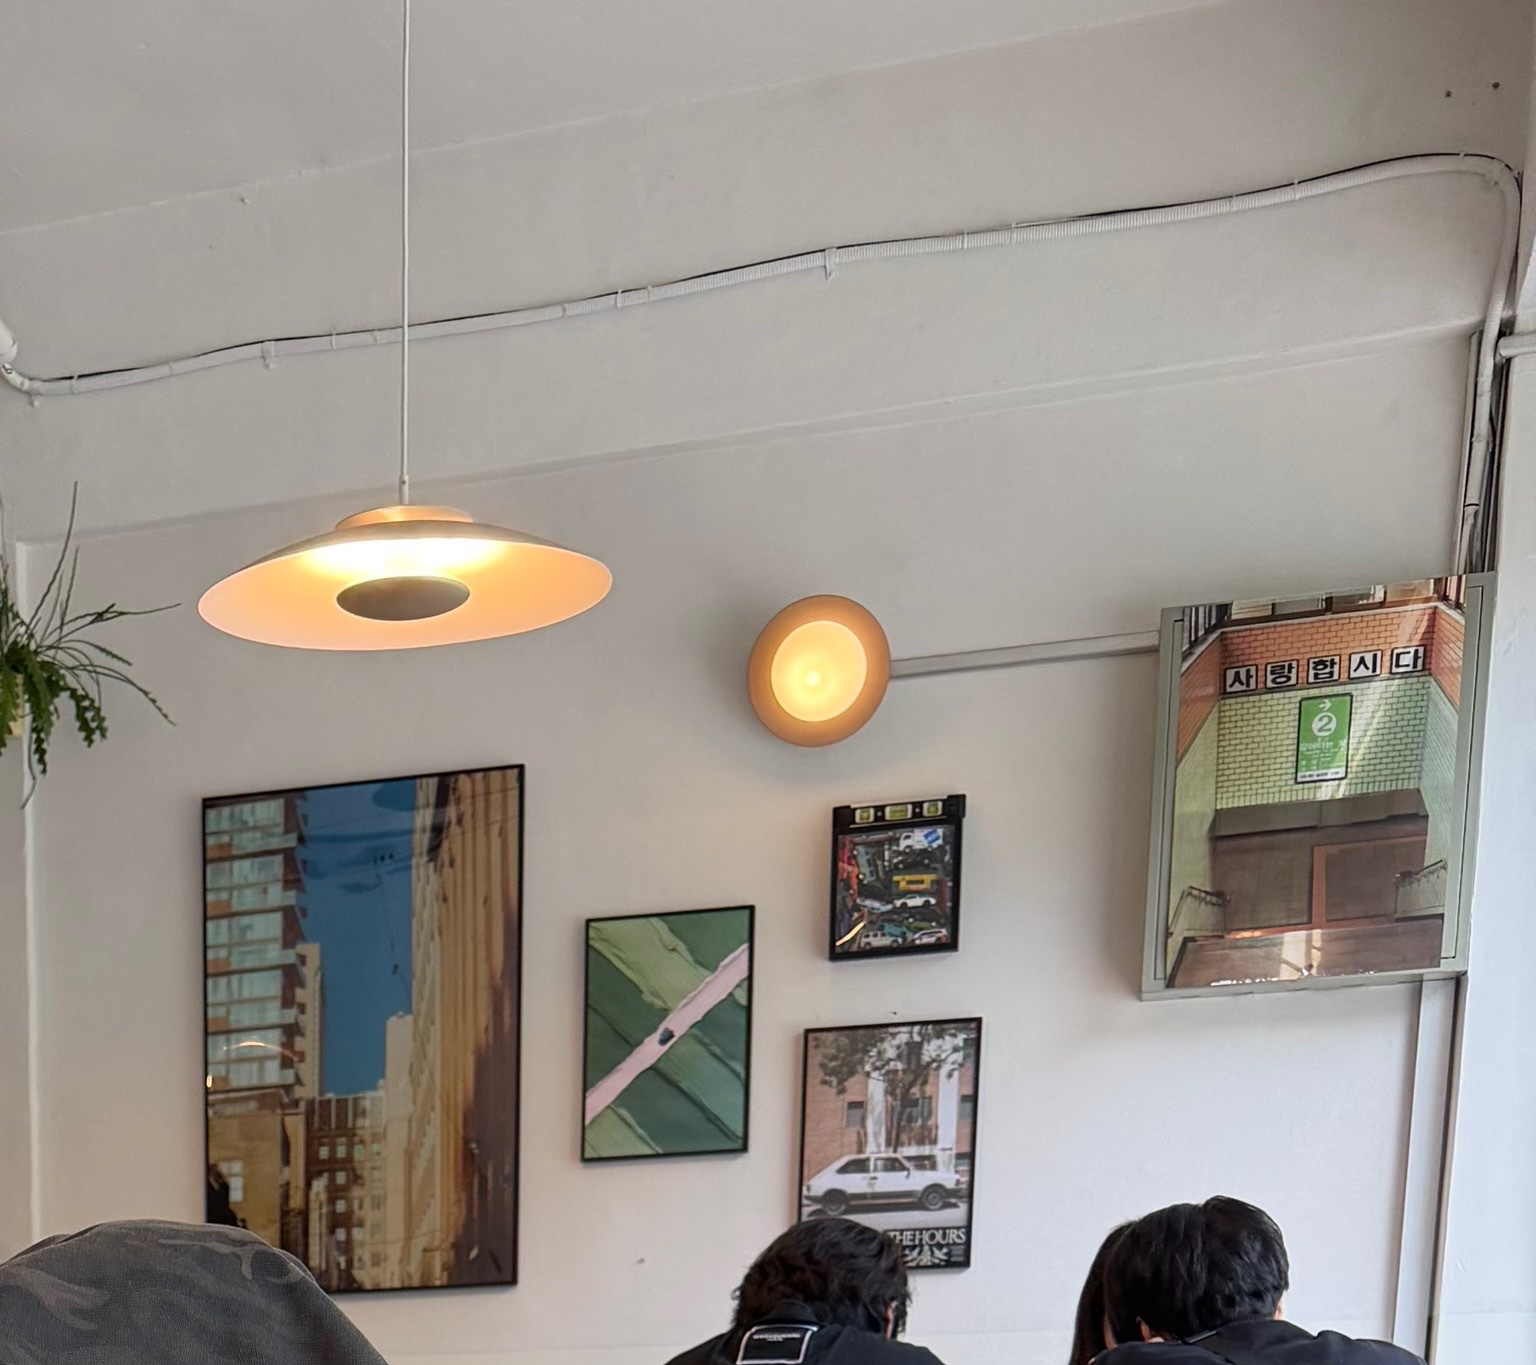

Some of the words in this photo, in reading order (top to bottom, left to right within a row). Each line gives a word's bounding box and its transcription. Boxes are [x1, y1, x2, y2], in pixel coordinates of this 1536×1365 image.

[1228, 647, 1422, 690] 사랑합시다
[1317, 714, 1333, 733] 2
[915, 1228, 966, 1246] HOURS
